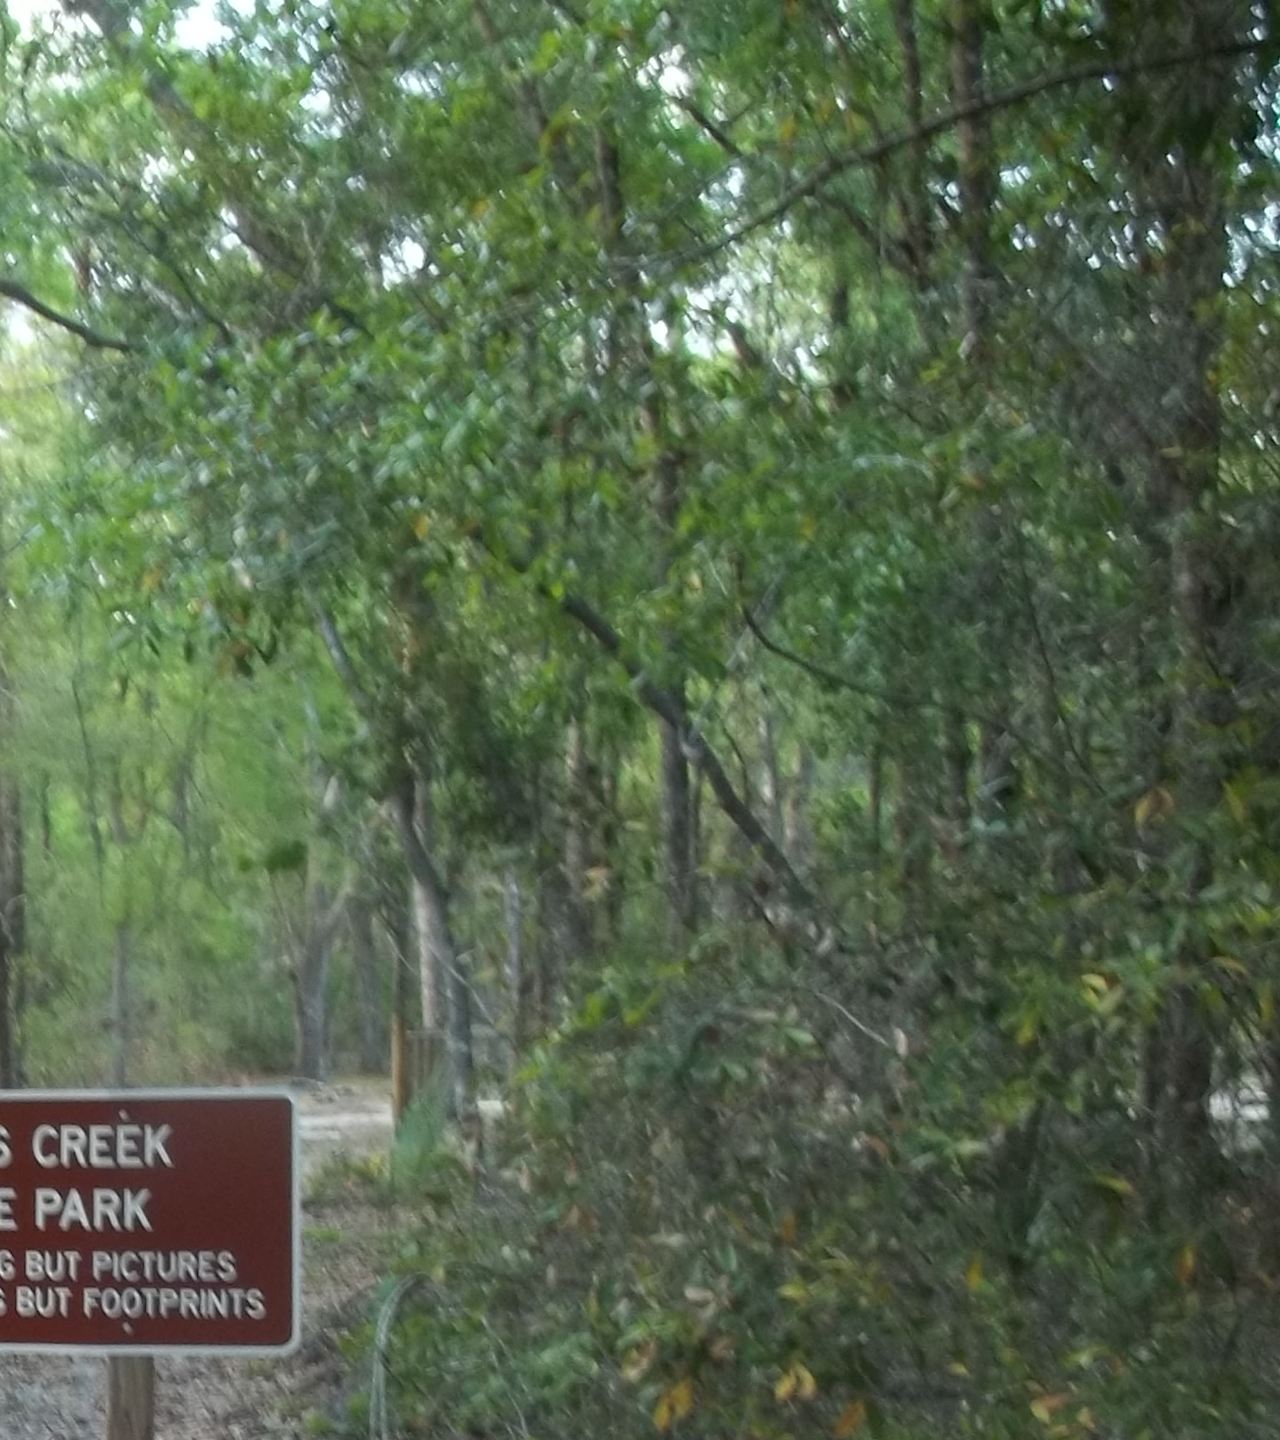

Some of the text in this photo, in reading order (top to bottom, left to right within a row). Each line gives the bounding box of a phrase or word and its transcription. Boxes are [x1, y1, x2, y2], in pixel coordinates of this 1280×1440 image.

[32, 1124, 172, 1168] CREEK
[35, 1188, 152, 1231] PARK
[25, 1250, 82, 1281] BUT
[92, 1251, 237, 1282] PICTURES
[16, 1286, 72, 1317] BUT
[82, 1287, 266, 1319] FOOTPRINTS
